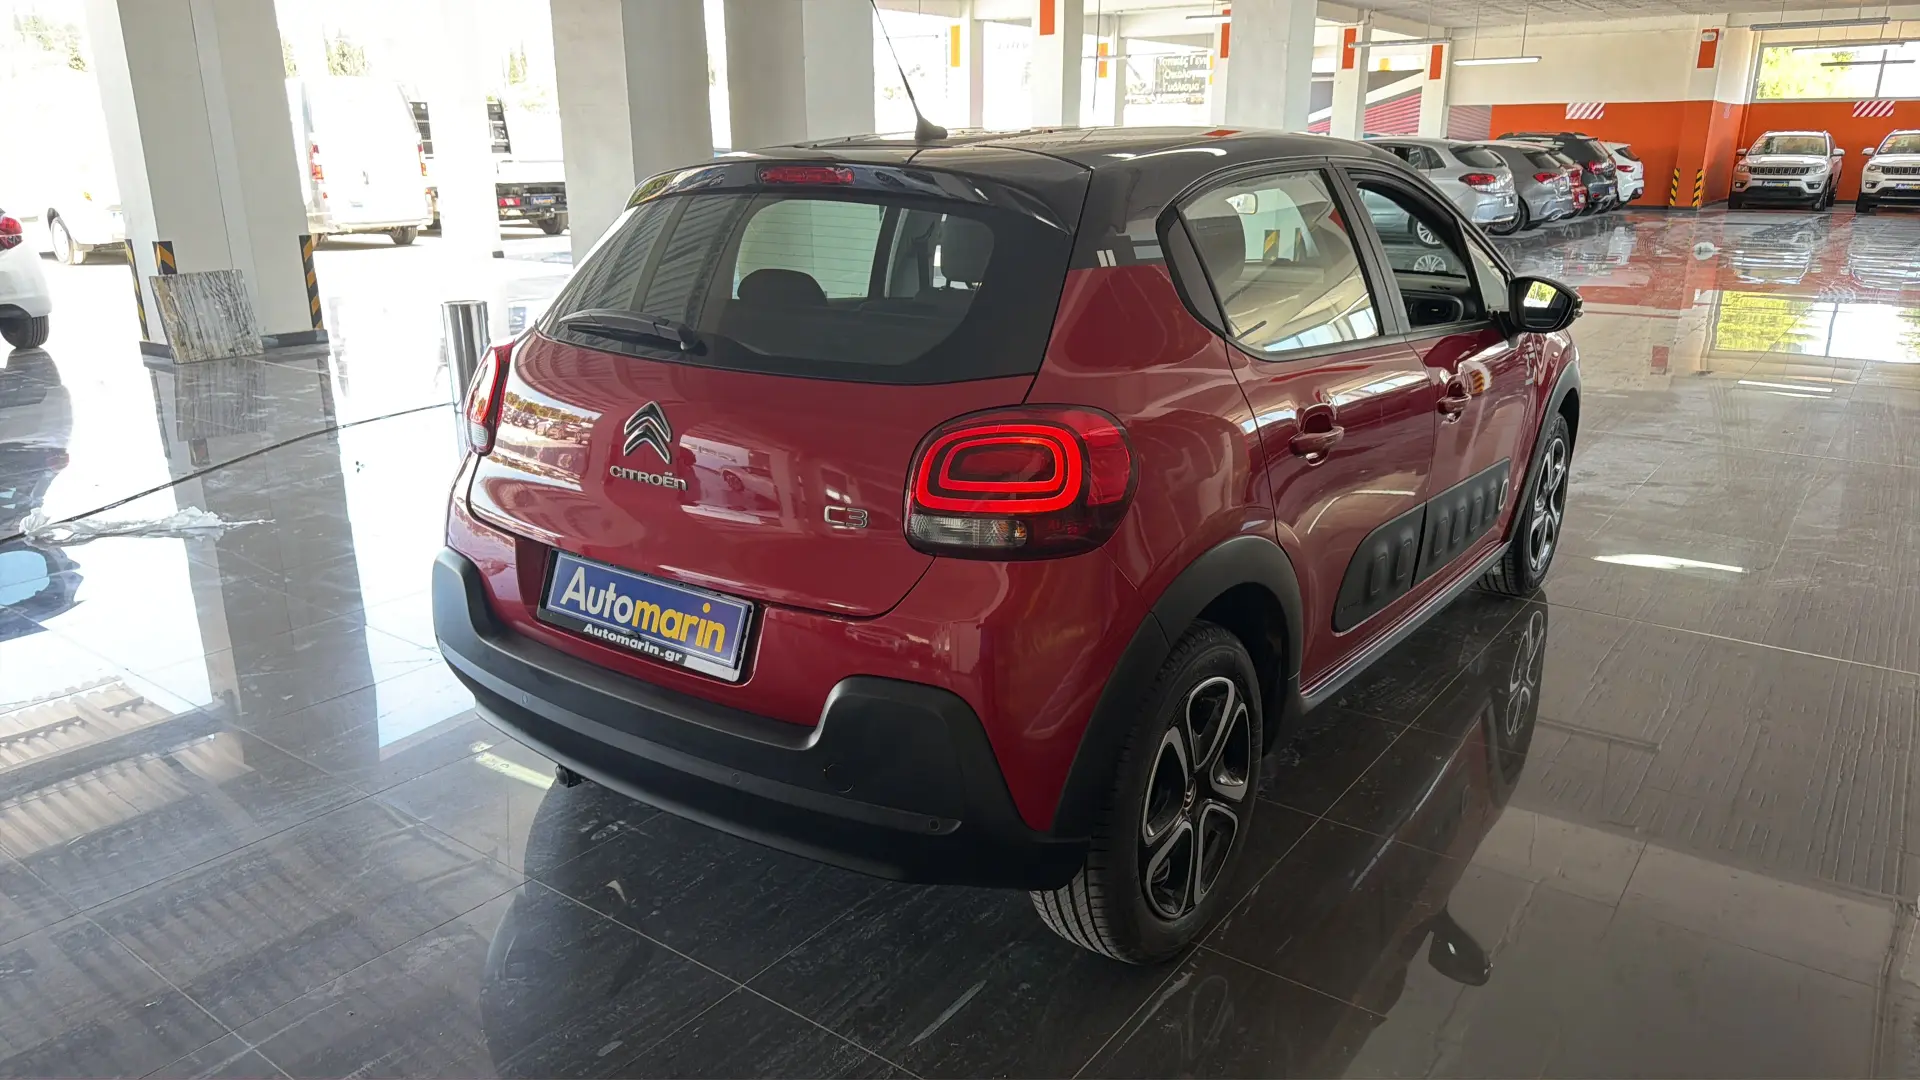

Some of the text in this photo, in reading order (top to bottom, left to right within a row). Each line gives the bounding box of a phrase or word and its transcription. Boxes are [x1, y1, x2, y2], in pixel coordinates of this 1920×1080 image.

[824, 504, 868, 528] C3
[559, 566, 726, 653] Automarin
[583, 623, 682, 663] Automarin.gr
